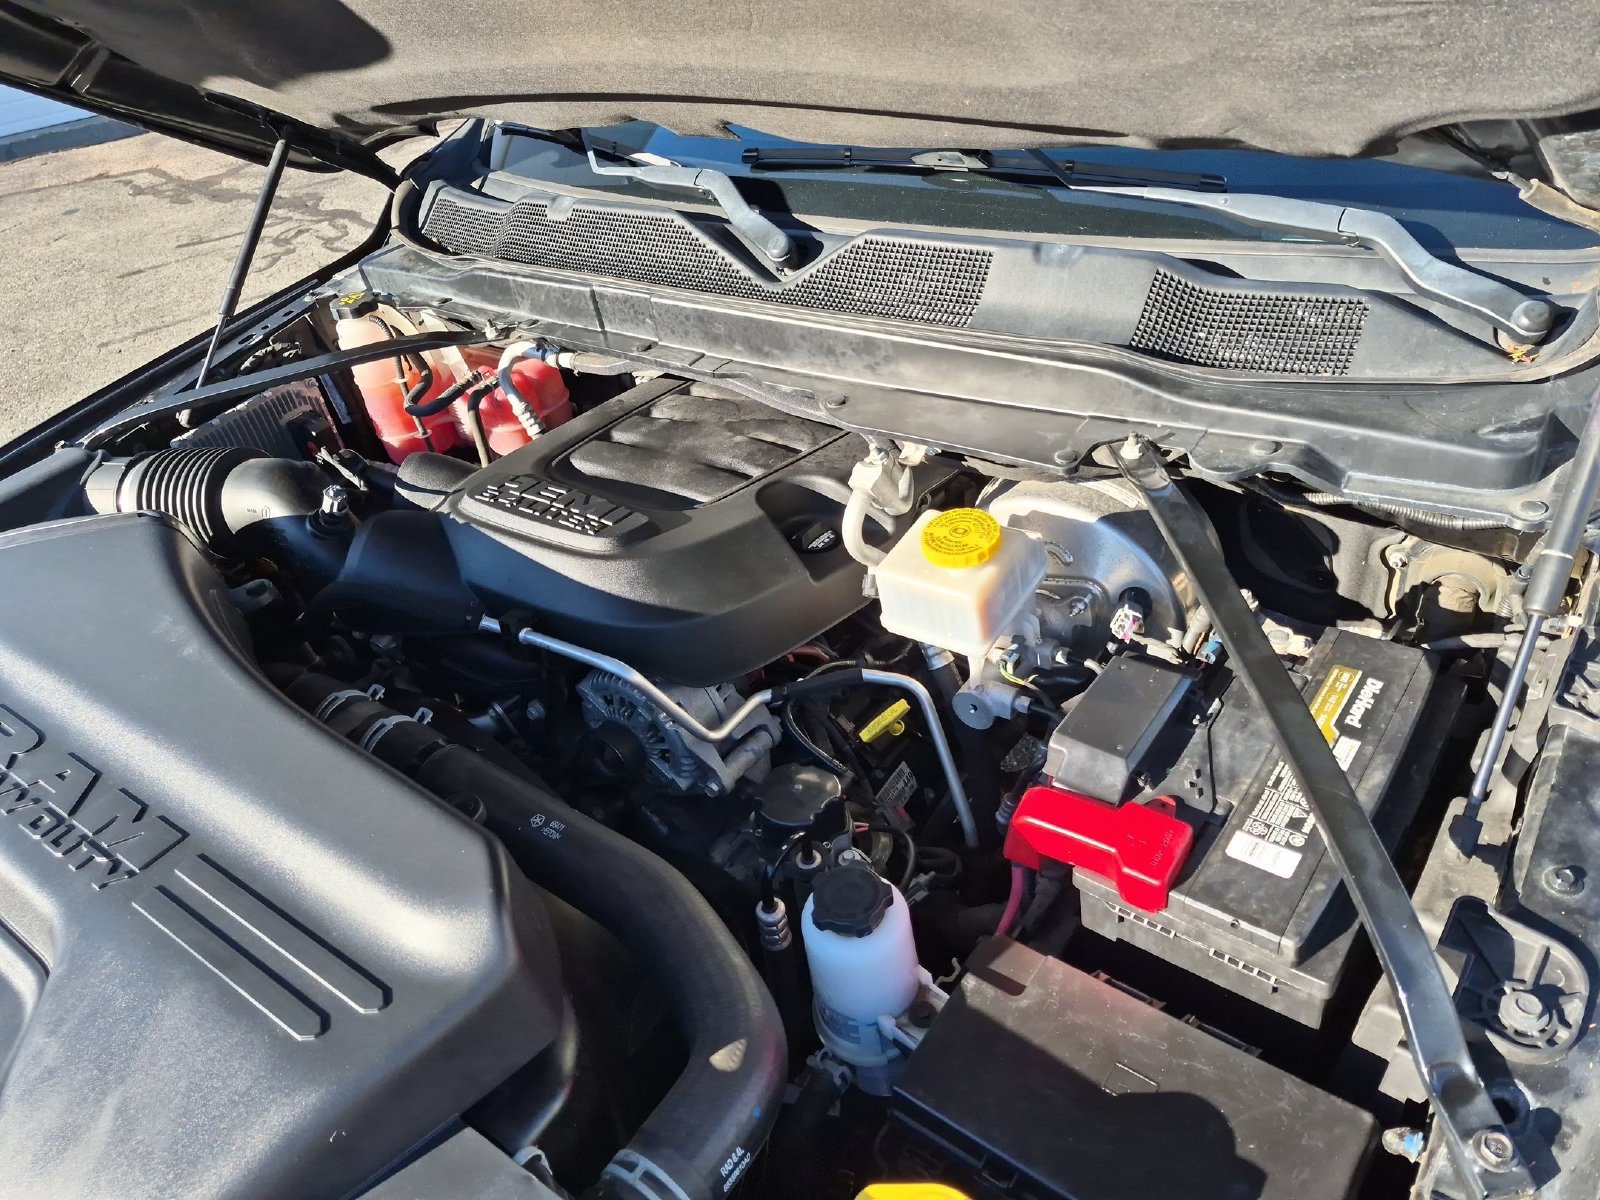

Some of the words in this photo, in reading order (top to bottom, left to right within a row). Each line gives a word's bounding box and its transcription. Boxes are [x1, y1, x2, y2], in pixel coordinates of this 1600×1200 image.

[486, 475, 634, 527] HEMI
[517, 498, 603, 536] LITER
[1344, 677, 1384, 728] DieHard
[0, 703, 192, 873] RAM
[17, 799, 141, 891] DUTY
